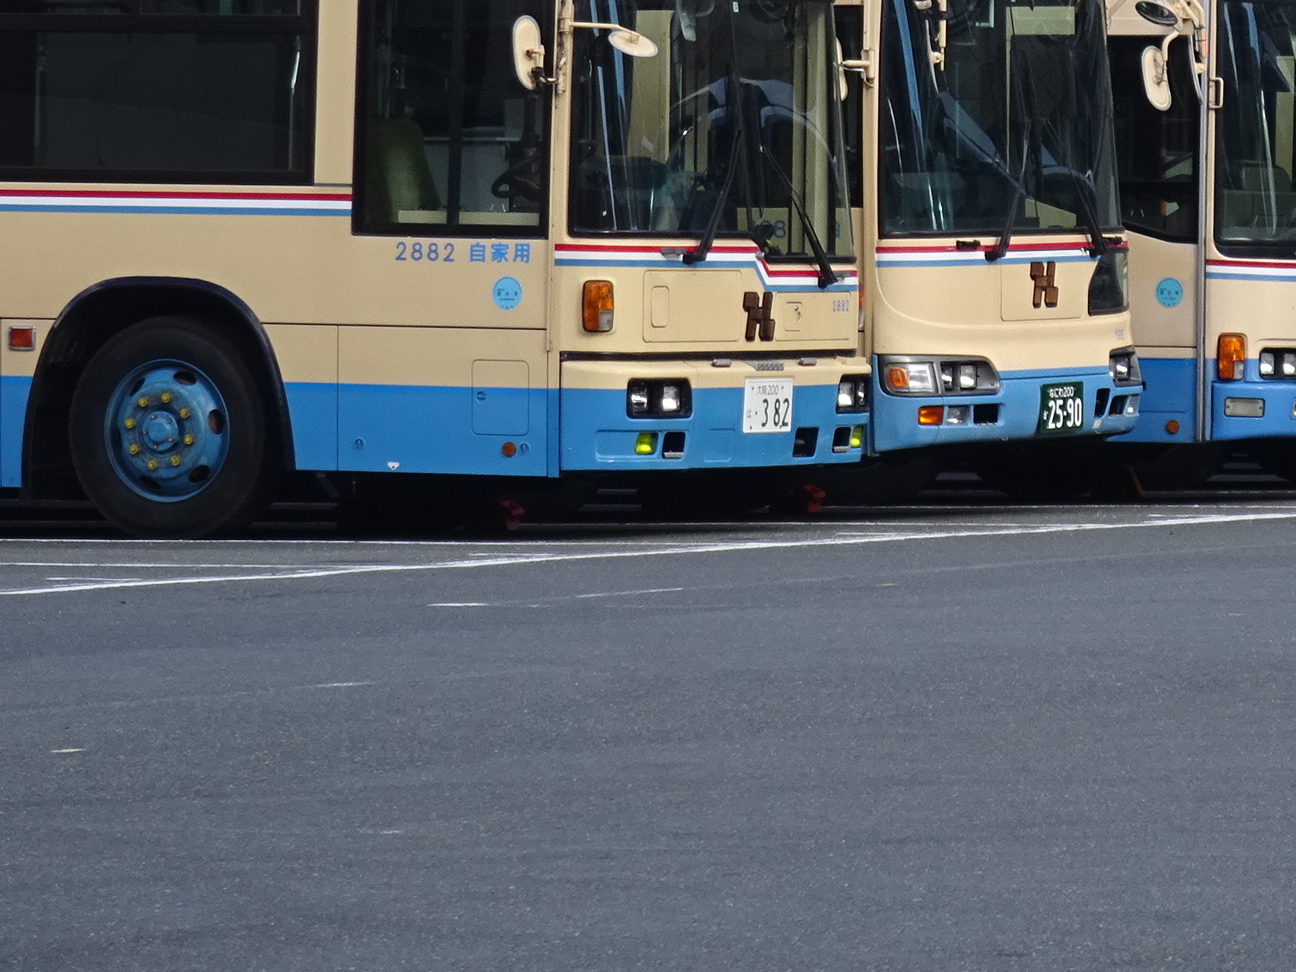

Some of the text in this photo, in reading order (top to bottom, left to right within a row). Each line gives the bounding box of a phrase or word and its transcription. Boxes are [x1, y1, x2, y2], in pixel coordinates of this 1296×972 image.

[395, 241, 531, 263] 2882 自家用
[761, 397, 790, 428] 382
